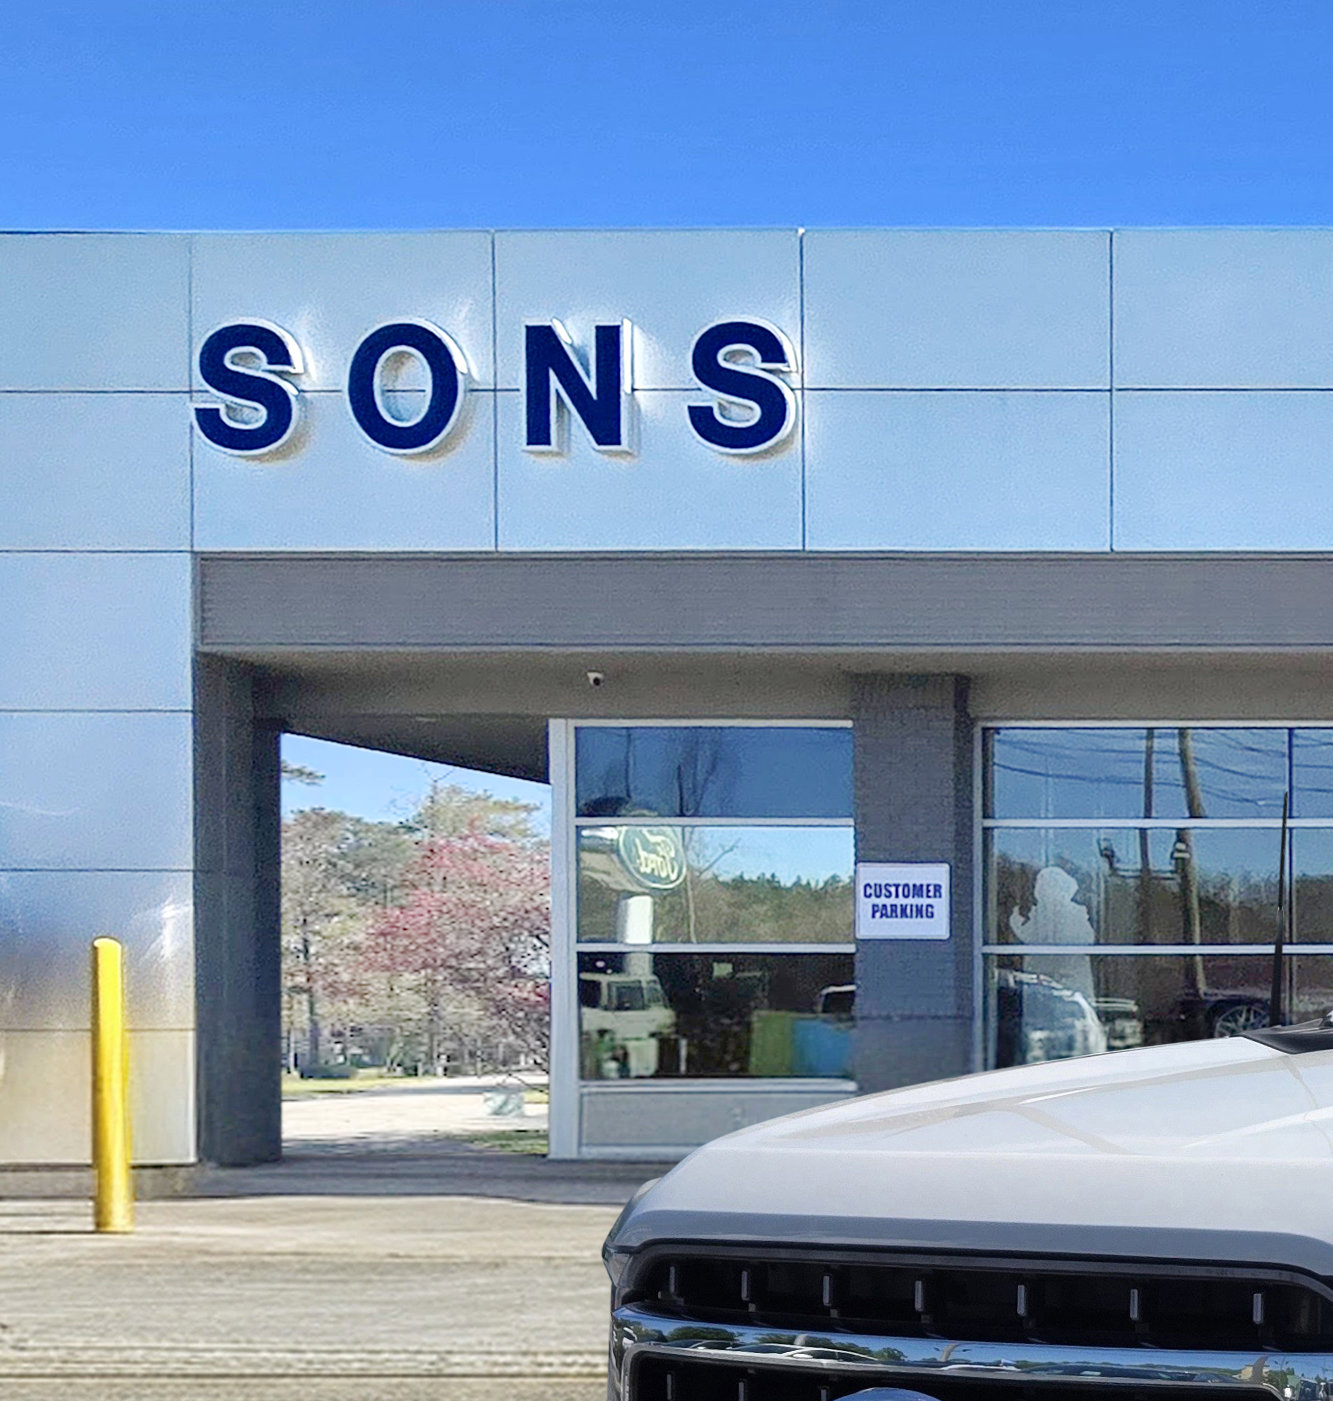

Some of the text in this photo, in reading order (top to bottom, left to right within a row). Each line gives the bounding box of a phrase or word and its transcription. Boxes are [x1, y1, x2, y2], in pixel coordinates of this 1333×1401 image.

[194, 319, 799, 455] SONS
[863, 882, 942, 899] CUSTOMER
[871, 903, 934, 919] PARKING
